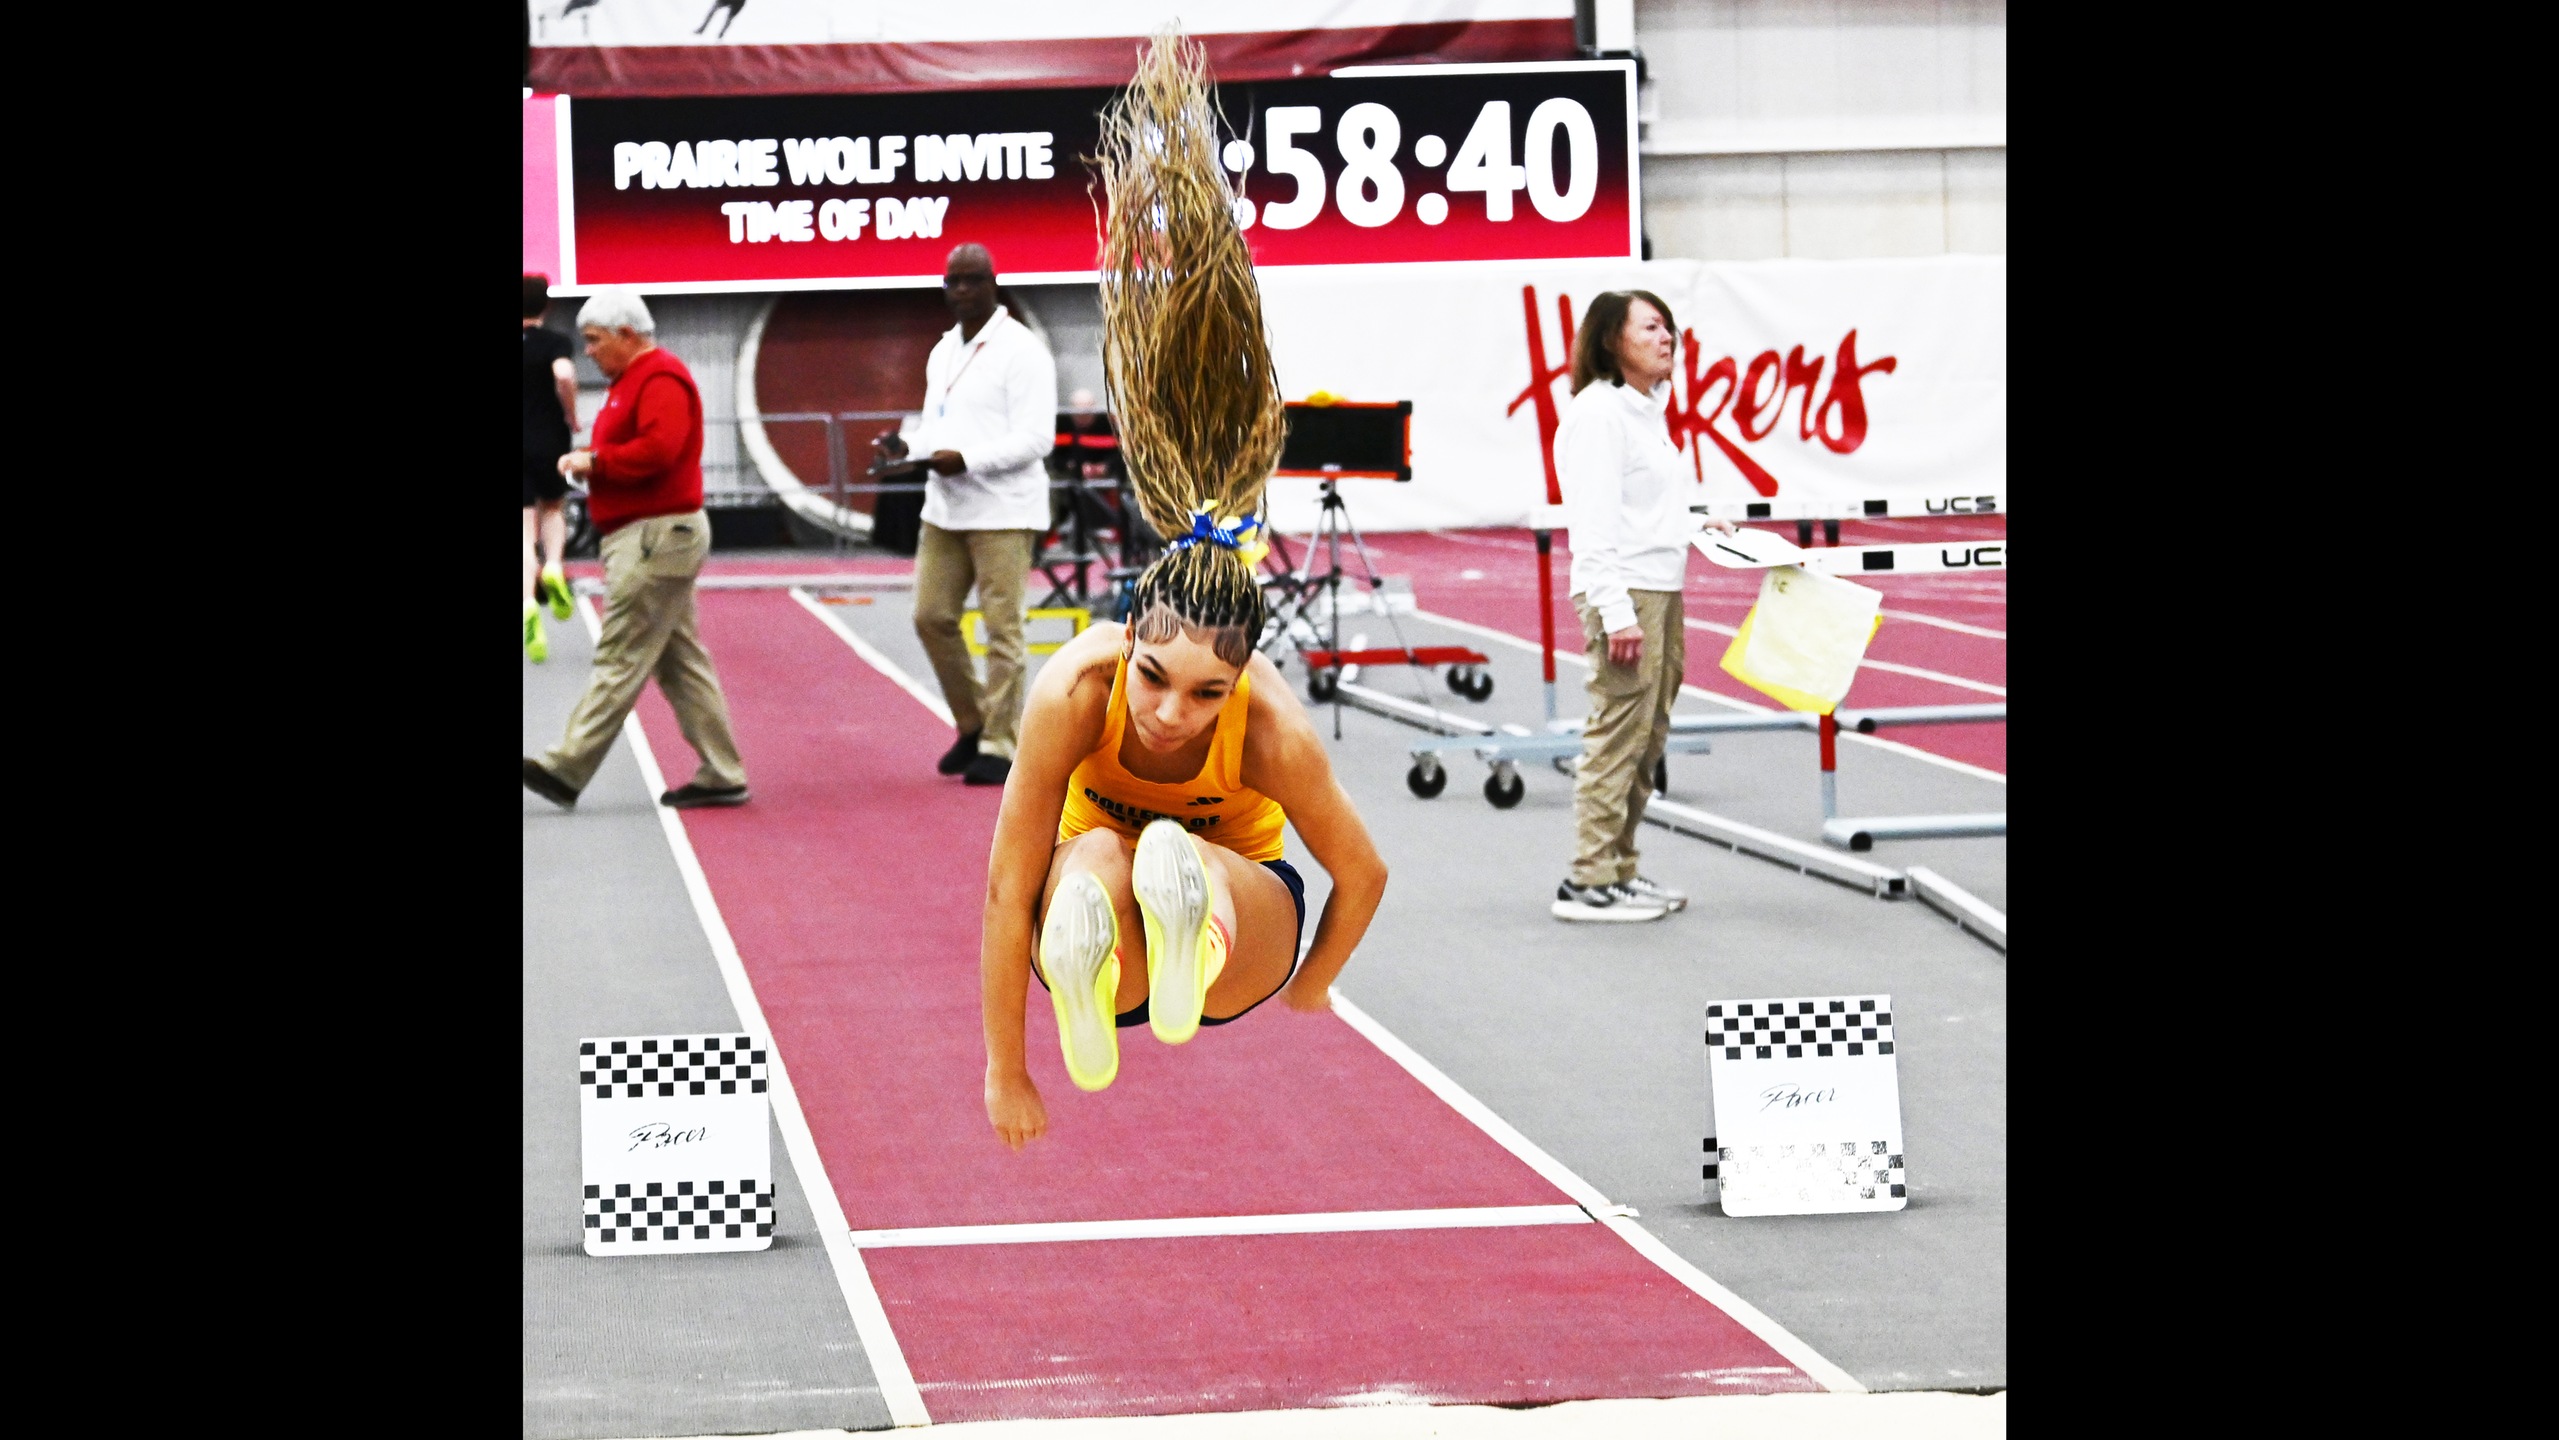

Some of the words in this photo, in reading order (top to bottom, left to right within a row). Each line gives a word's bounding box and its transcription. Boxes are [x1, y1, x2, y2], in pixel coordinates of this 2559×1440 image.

[613, 139, 780, 191] PRAIRIE
[782, 136, 907, 186] WOLF
[913, 132, 1055, 182] INVITE
[1143, 97, 1599, 231] :58:40
[721, 201, 816, 243] TIME
[818, 198, 871, 241] OF
[875, 196, 949, 239] DAY
[1507, 284, 1898, 504] Hkers
[1925, 496, 1996, 513] UCS
[1942, 547, 2006, 567] UC
[1189, 815, 1221, 828] OF
